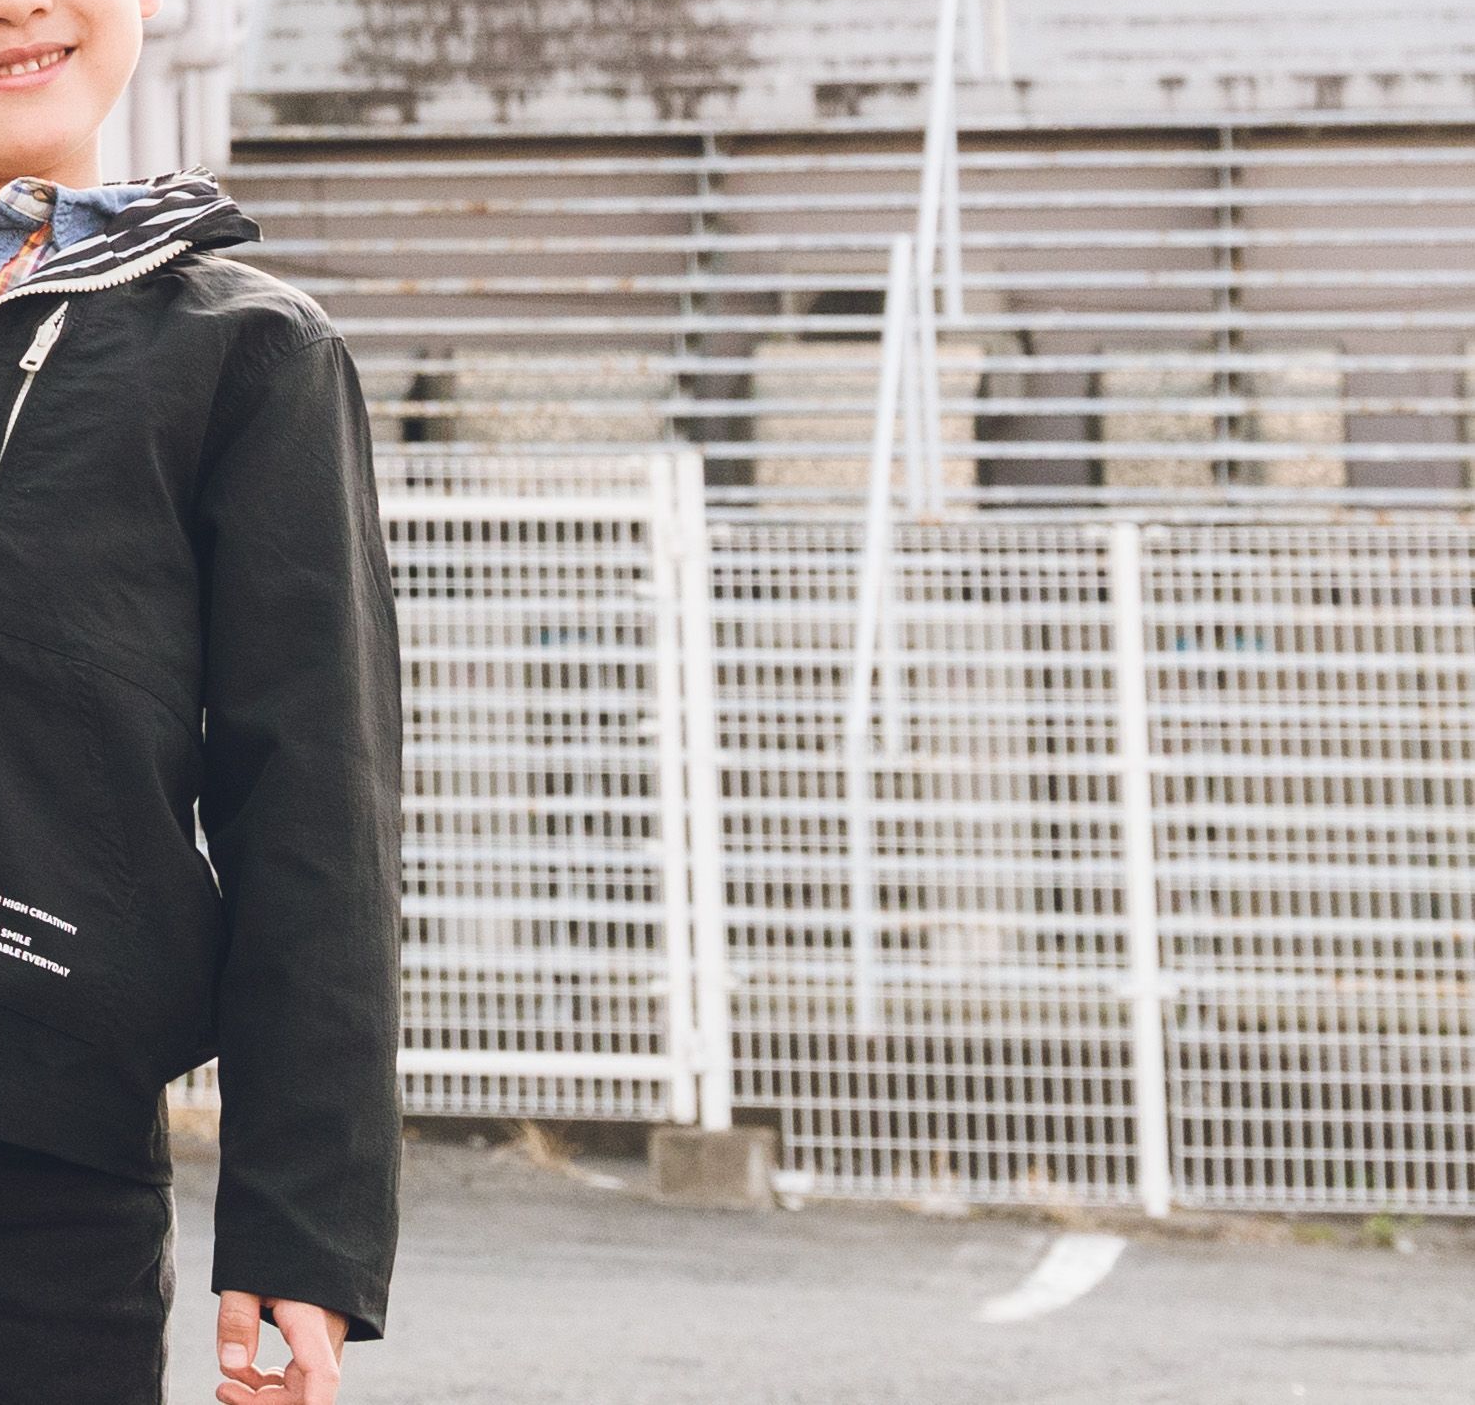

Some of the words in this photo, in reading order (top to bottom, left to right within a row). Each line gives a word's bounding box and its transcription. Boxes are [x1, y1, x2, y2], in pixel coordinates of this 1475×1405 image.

[2, 898, 29, 914] HIGH
[29, 907, 78, 935] CREATIVITY
[0, 928, 32, 946] SMILE
[21, 951, 71, 977] EVERYDAY
